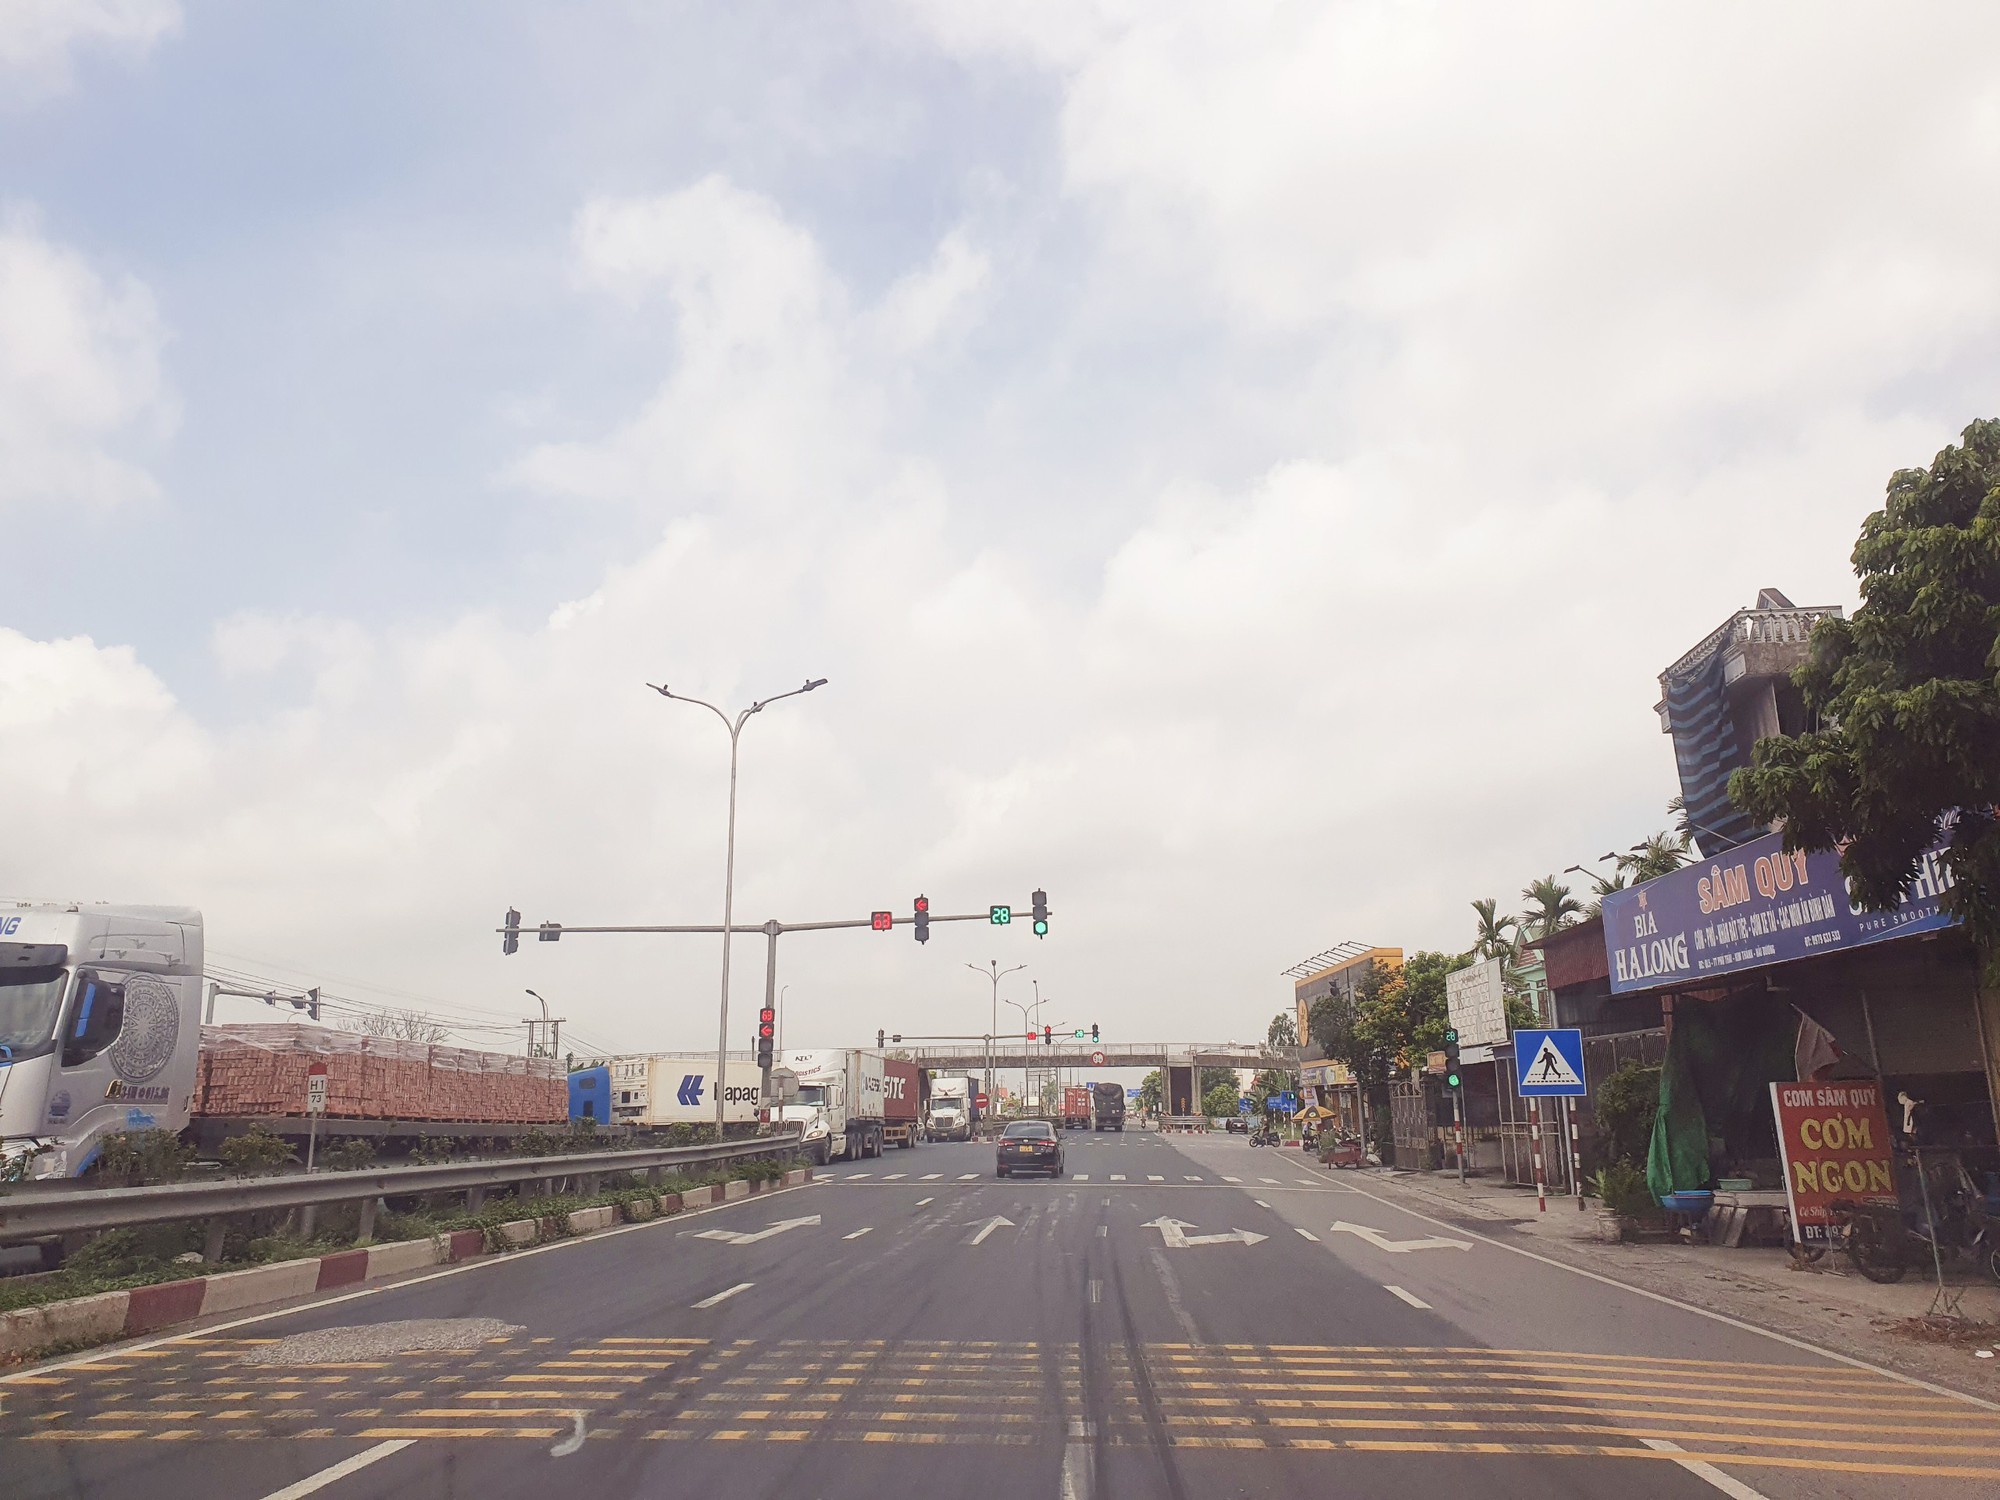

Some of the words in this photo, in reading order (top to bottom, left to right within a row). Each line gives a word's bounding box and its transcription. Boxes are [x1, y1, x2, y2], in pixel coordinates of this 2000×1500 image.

[1697, 864, 1751, 914] SÂM
[992, 907, 1009, 923] 28
[1633, 911, 1658, 938] BIA
[1860, 918, 1886, 931] PURE
[1893, 905, 1940, 924] SMOOTH
[1445, 1031, 1456, 1041] 28
[311, 1094, 322, 1103] 73
[884, 1075, 907, 1099] SITC
[1816, 1086, 1848, 1106] SÂM
[1801, 1111, 1874, 1150] CƠM
[1793, 1160, 1893, 1193] NGON
[1805, 1225, 1823, 1239] ĐT:
